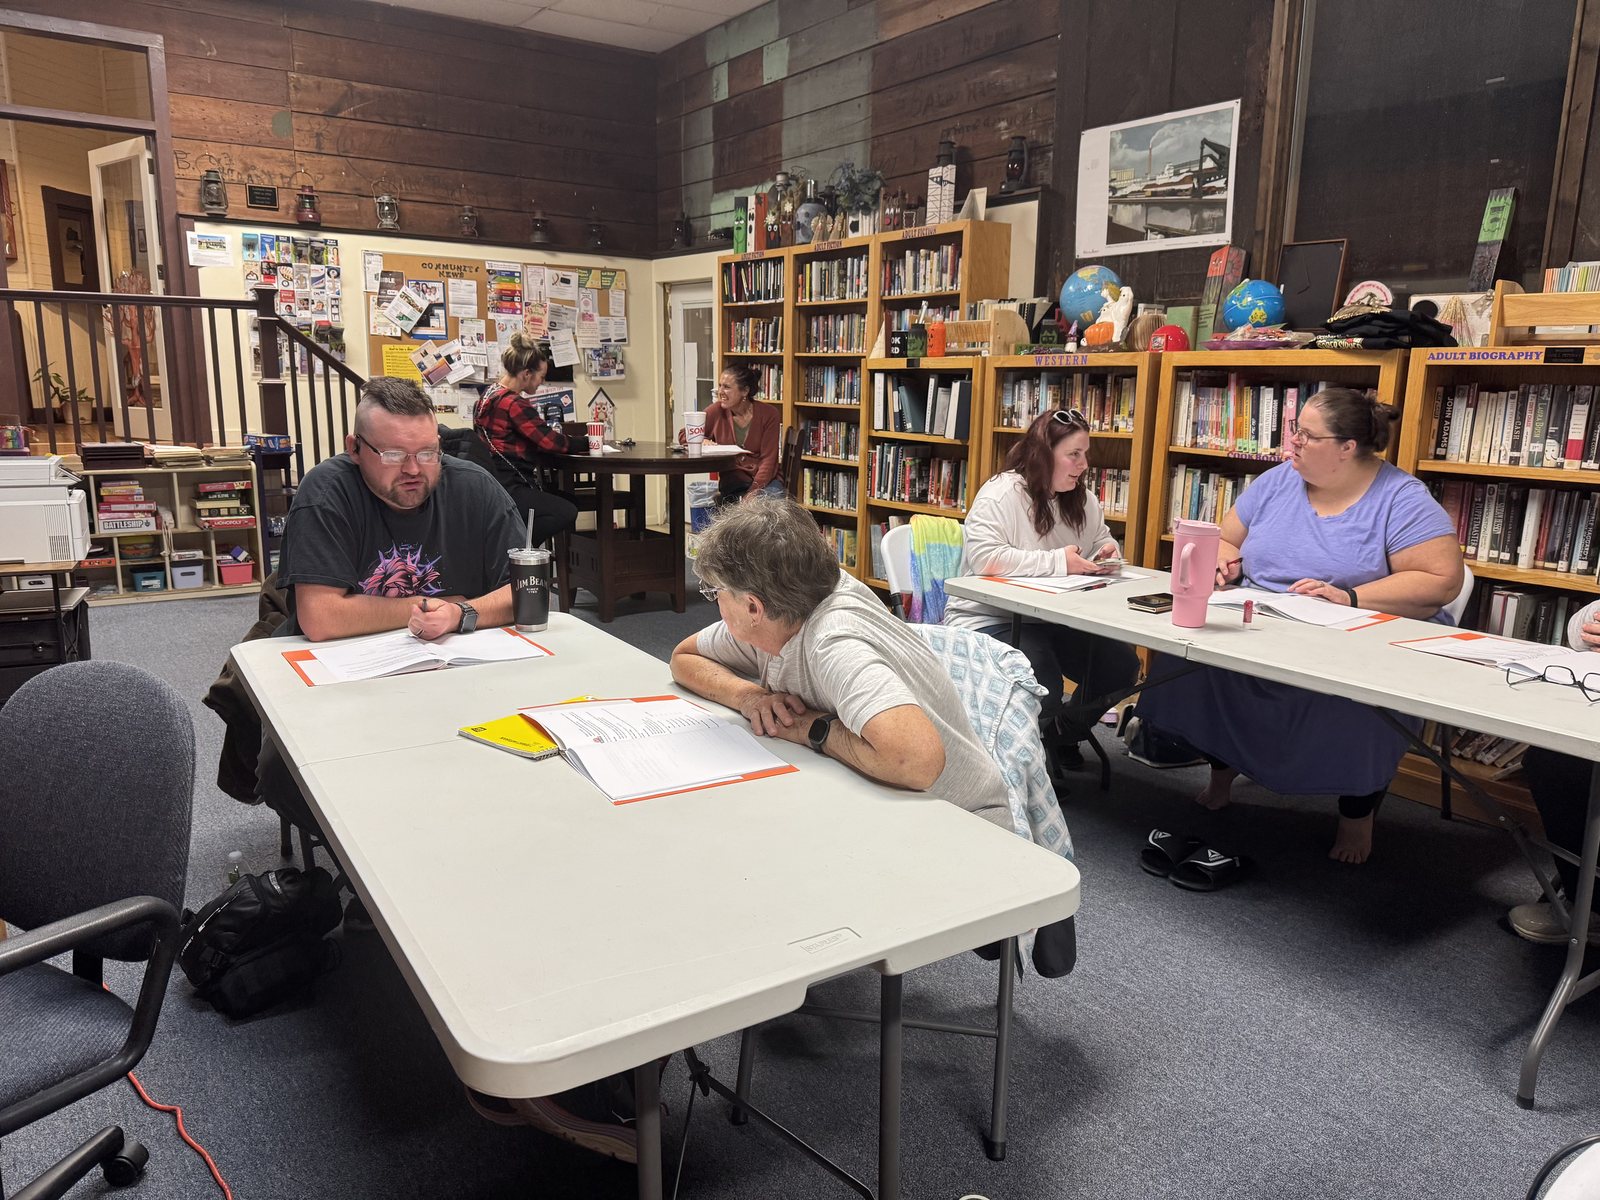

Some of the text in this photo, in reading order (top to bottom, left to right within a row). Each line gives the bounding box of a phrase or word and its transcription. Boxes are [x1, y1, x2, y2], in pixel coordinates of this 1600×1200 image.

[902, 226, 936, 238] ADULT FICTION
[1034, 354, 1088, 366] WESTERN
[1428, 352, 1466, 360] ADULT
[1468, 351, 1543, 360] BIOGRAPHY
[1534, 402, 1546, 438] LAURA BUSH
[1441, 420, 1450, 448] ADAMS
[1513, 421, 1522, 440] CASH
[1228, 451, 1253, 459] COOK
[103, 520, 143, 530] BATTLESHIP
[1470, 503, 1484, 547] PUPPETMASTER
[516, 579, 528, 591] JIM
[530, 576, 548, 590] BEAM
